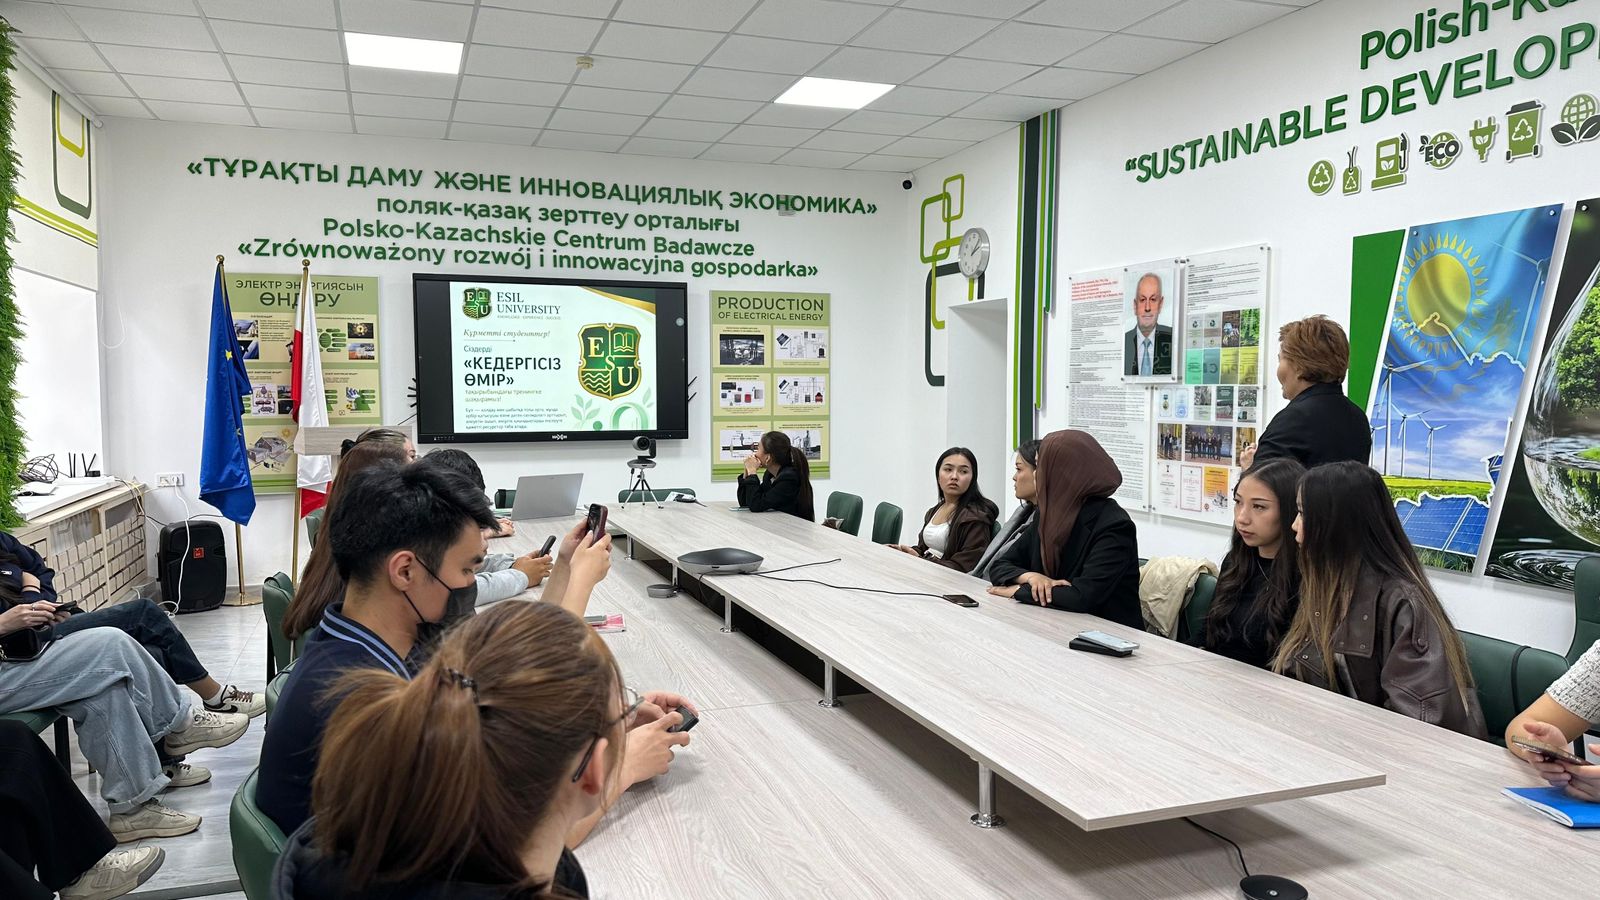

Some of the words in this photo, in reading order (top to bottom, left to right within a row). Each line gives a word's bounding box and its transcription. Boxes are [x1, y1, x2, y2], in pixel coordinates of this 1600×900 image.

[1125, 94, 1348, 183] “SUSTAINABLE
[1360, 22, 1600, 124] DEVELOP
[1424, 140, 1460, 162] ECO
[187, 157, 338, 184] «ТҰРАҚТЫ
[347, 165, 423, 188] ДАМУ
[434, 170, 511, 193] ЖӘНЕ
[520, 174, 723, 210] ИННОВАЦИЯЛЫҚ
[729, 191, 878, 214] ЭКОНОМИКА»
[377, 197, 531, 222] поляк-қазақ
[538, 205, 628, 229] зерттеу
[634, 213, 739, 232] орталығы
[323, 217, 546, 246] Polsko-Kazachskie
[553, 230, 646, 251] Centrum
[653, 236, 755, 256] Badawcze
[237, 237, 444, 265] «Zrównoważony
[453, 246, 532, 268] rozwój
[539, 249, 545, 267] i
[552, 251, 685, 275] innowacyjna
[690, 259, 818, 278] gospodarka»
[236, 280, 282, 289] ЭЛЕКТР
[286, 281, 364, 291] ЭНРГИЯСЫН
[497, 291, 524, 303] ESIL
[718, 296, 824, 311] PRODUCTION
[497, 304, 561, 315] UNIVERSITY
[718, 311, 731, 319] OF
[733, 312, 787, 320] ELECTRICAL
[463, 357, 561, 371] «КЕДЕРГІСІЗ
[464, 373, 514, 386] ӨМІР»
